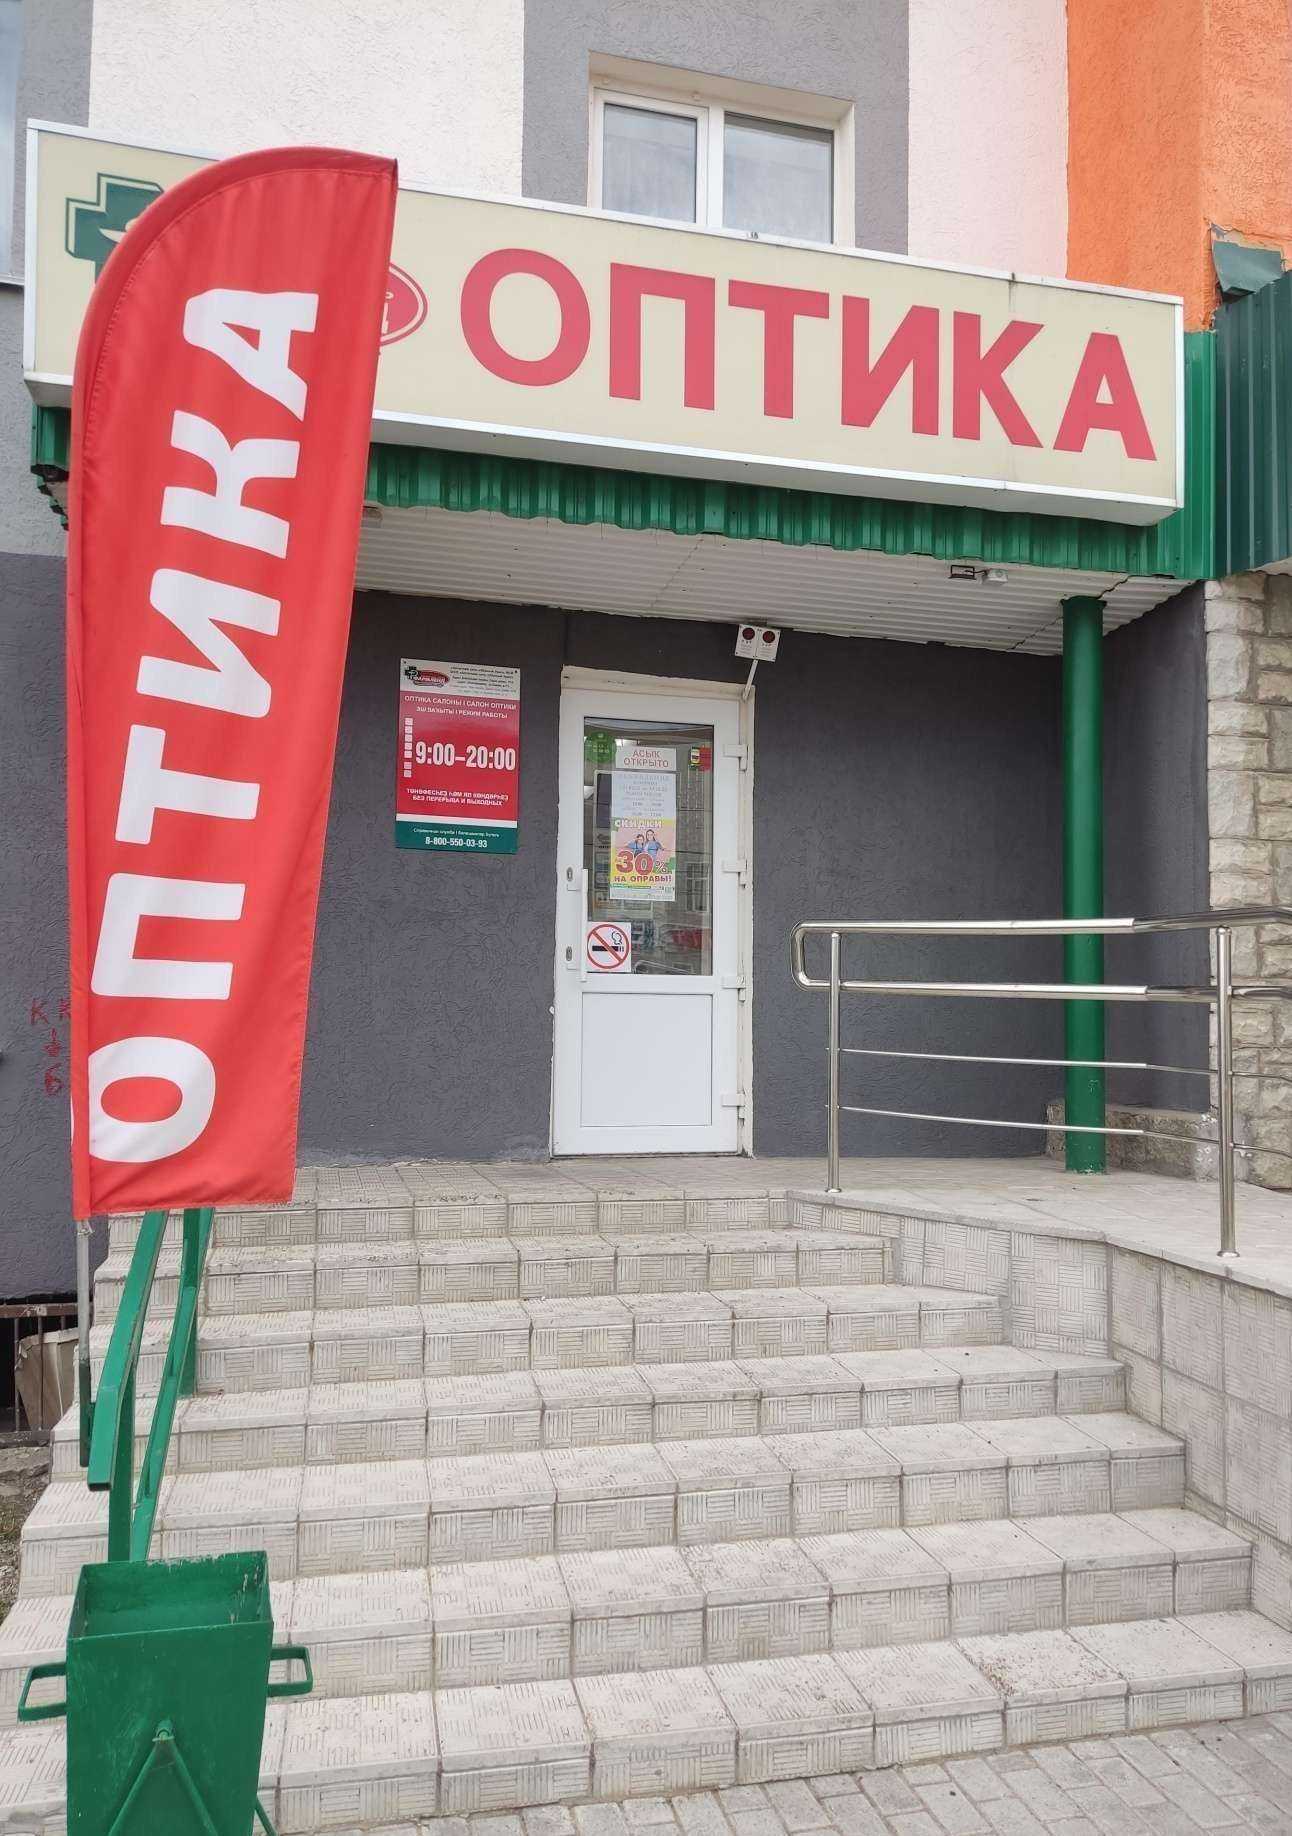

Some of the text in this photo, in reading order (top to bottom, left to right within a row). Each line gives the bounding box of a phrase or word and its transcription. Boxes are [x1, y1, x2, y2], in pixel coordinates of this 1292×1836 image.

[461, 247, 1156, 460] ОПТИКА
[404, 695, 432, 704] ОПТИКА
[466, 701, 489, 709] САЛОН
[87, 287, 320, 1164] ОПТИКА
[623, 758, 669, 767] ОТКРЫТО
[425, 836, 488, 848] 8-800-550-03-93
